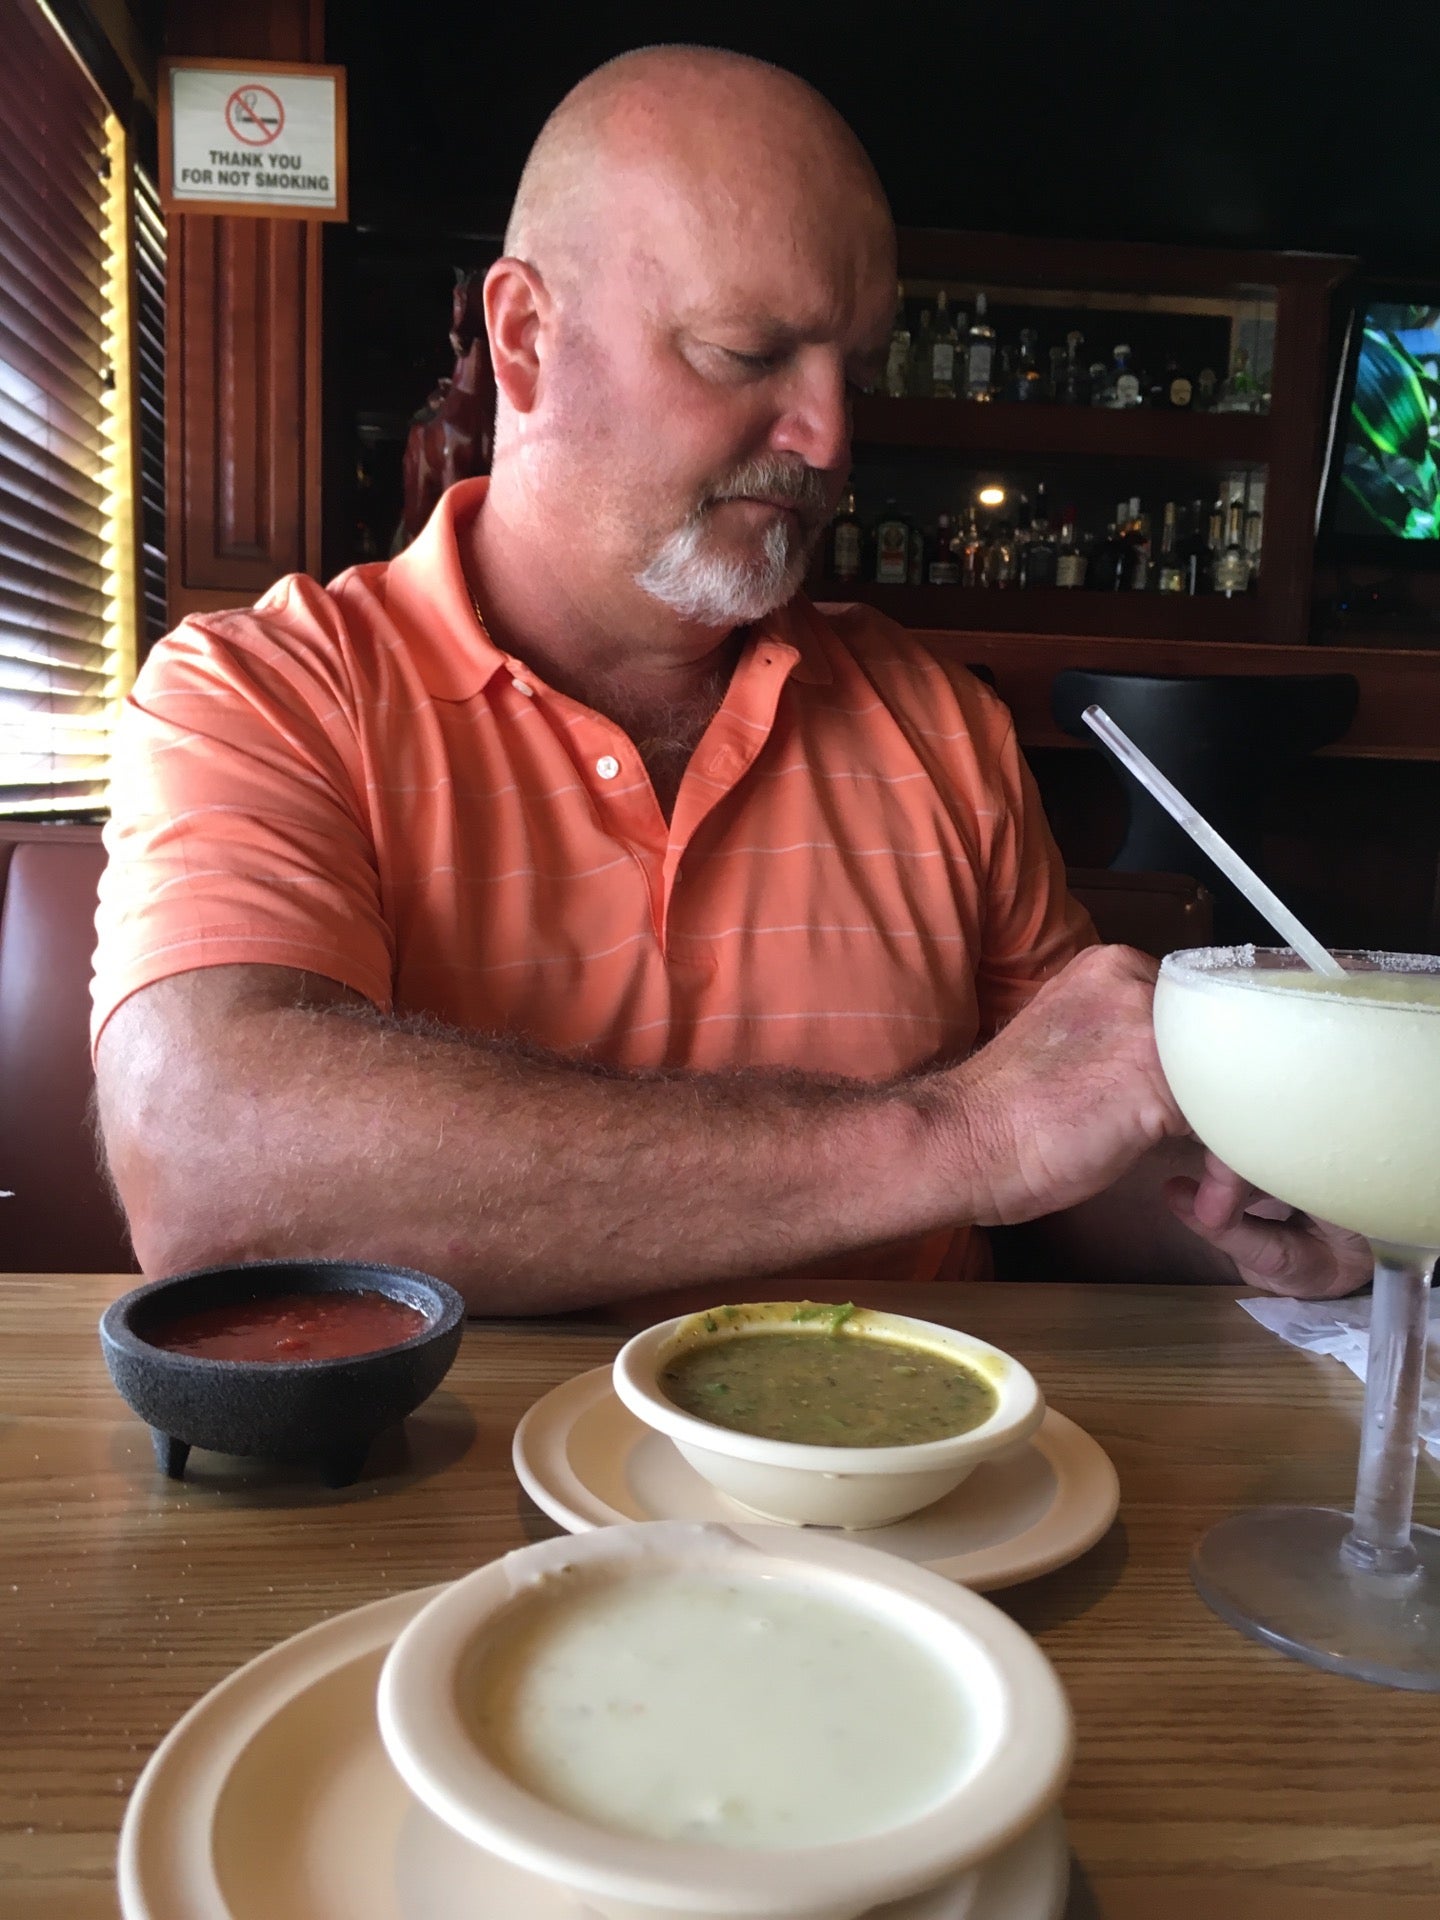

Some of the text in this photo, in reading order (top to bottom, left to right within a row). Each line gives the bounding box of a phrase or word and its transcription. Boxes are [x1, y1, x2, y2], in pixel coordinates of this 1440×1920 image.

[209, 150, 301, 170] THANK YOU
[181, 168, 329, 191] FOR NOT SMOKING
